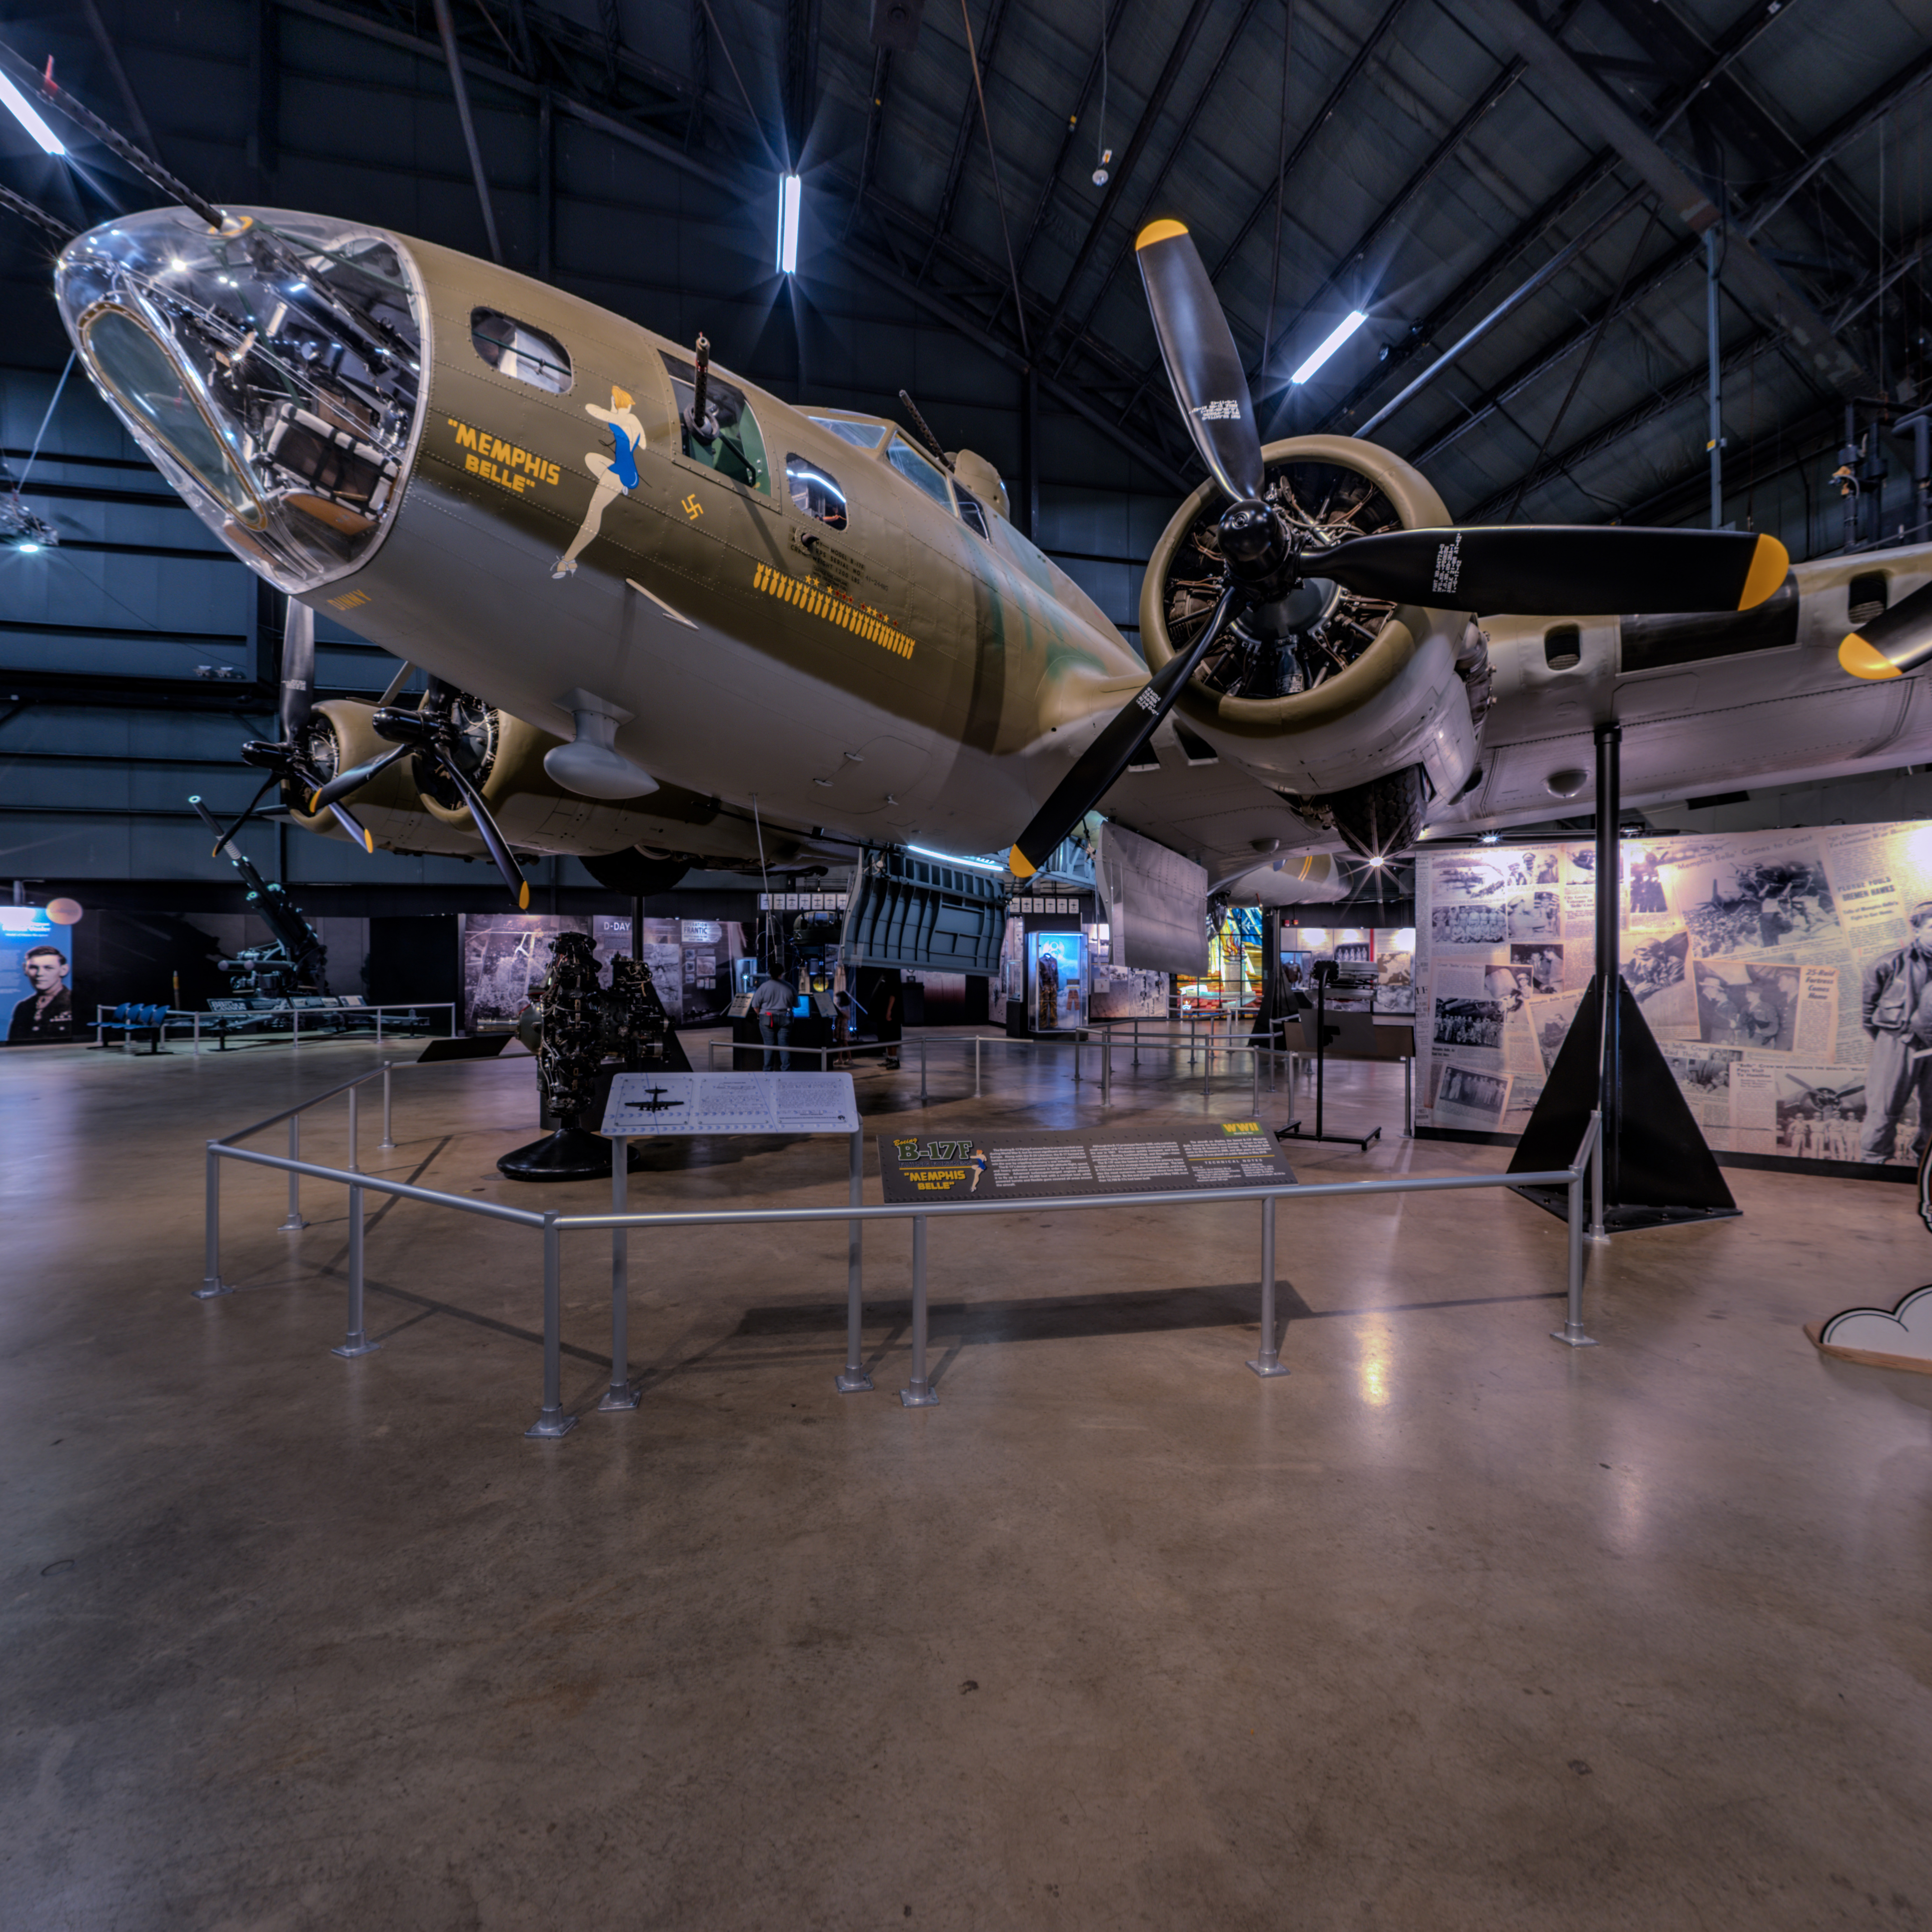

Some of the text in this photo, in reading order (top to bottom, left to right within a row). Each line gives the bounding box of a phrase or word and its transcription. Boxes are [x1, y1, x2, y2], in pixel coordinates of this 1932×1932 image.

[448, 418, 560, 486] "MEMPHIS
[465, 454, 535, 493] BELLE"
[830, 548, 847, 560] MODEL
[812, 556, 833, 570] WEIGHT
[835, 567, 849, 578] 1200
[830, 557, 849, 570] SERIAL
[327, 589, 372, 611] DINNY
[1741, 846, 1770, 856] Comes
[1786, 835, 1813, 846] Coast
[1870, 885, 1896, 896] HAWKS
[604, 922, 631, 931] D-DAY
[1223, 1123, 1259, 1132] WWII
[894, 1138, 917, 1146] Boeing
[897, 1141, 973, 1161] B-17F
[904, 1170, 966, 1182] "MEMPHIS
[917, 1182, 955, 1190] BELLE"
